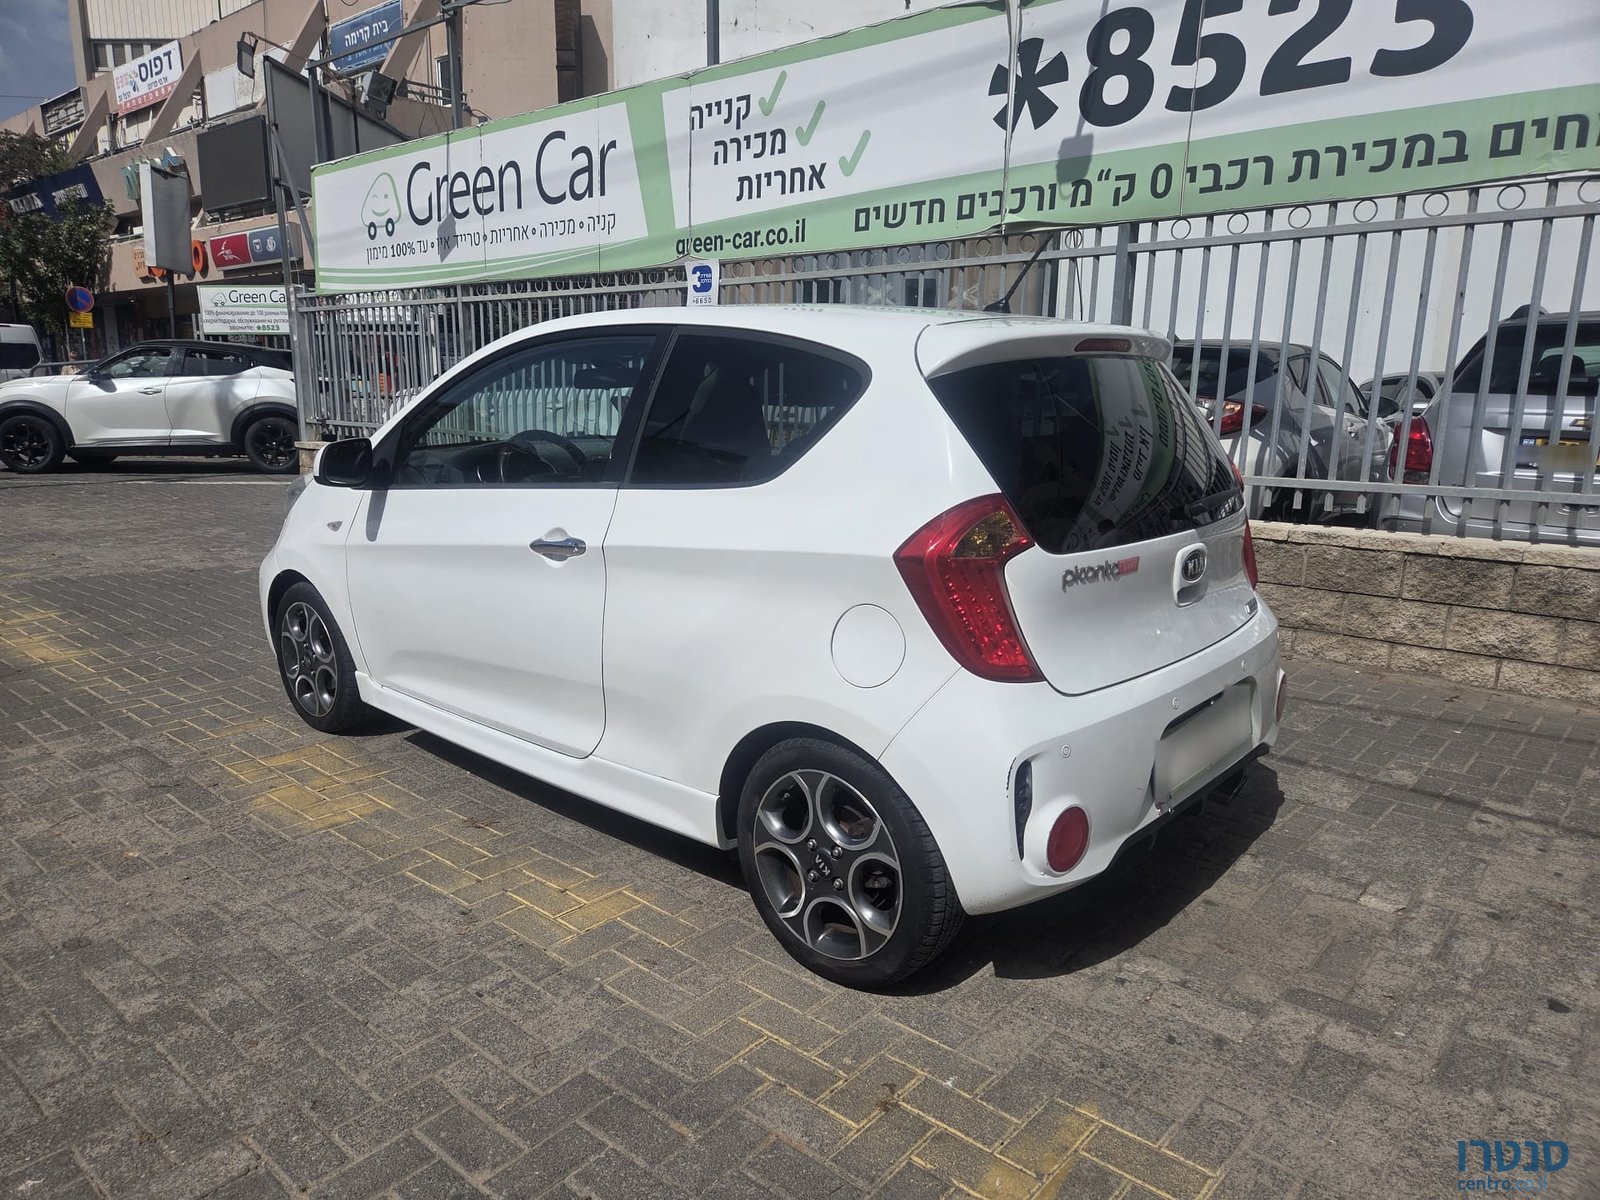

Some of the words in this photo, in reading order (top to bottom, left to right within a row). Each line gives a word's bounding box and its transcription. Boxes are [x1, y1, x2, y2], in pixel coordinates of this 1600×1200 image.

[373, 20, 389, 36] בית
[138, 50, 172, 82] דפוס
[690, 94, 751, 131] קנייה
[713, 128, 787, 166] מכירה
[1489, 113, 1600, 158] חים
[1287, 129, 1469, 183] במכירת
[406, 161, 523, 226] Green
[535, 130, 617, 205] Car
[736, 163, 827, 202] אחריות
[1150, 163, 1173, 199] 0
[1186, 155, 1274, 194] רכבי
[854, 198, 946, 232] חדשים
[957, 183, 1058, 221] ורכבים
[453, 232, 480, 248] טרייד
[490, 225, 529, 245] אחריות
[540, 219, 575, 238] מכירה
[587, 213, 616, 235] קניה
[675, 218, 806, 258] green-car.co.il
[366, 245, 388, 265] מימון
[391, 241, 415, 257] 100%
[417, 240, 428, 253] עד
[437, 236, 451, 255] אין
[228, 290, 266, 303] Green
[269, 290, 286, 303] Ca
